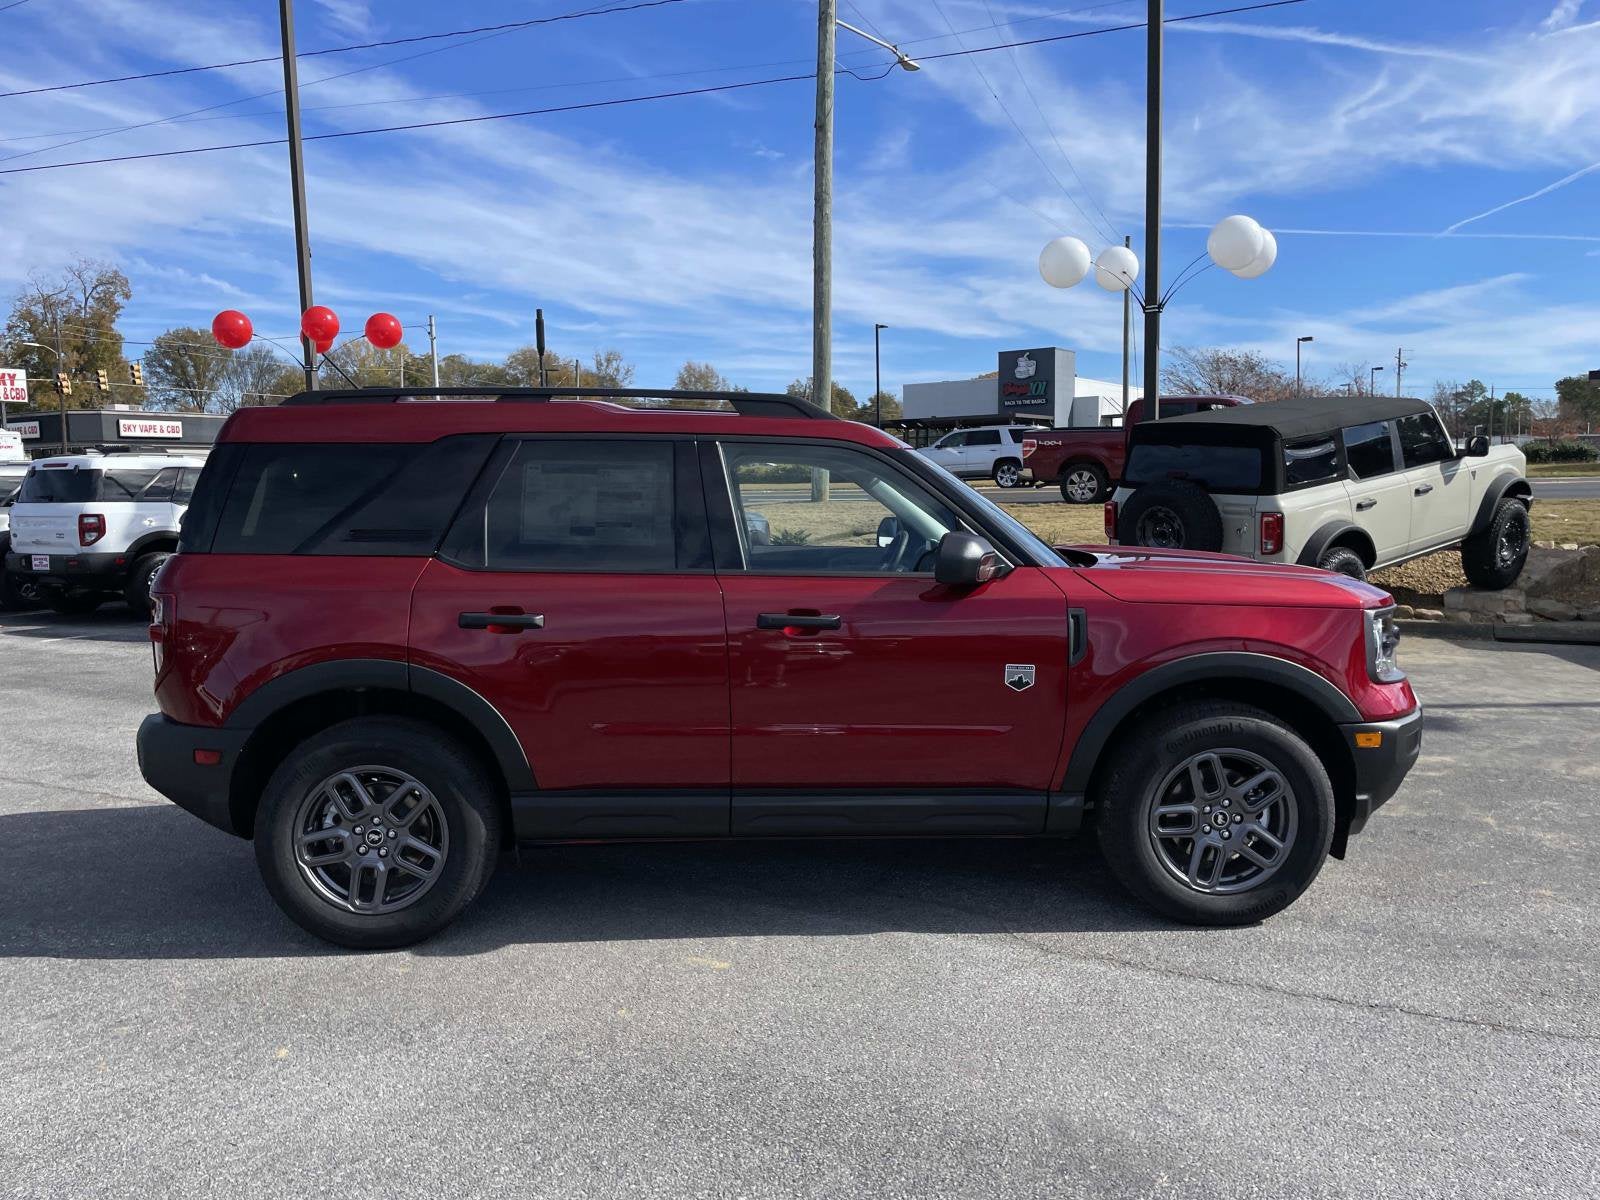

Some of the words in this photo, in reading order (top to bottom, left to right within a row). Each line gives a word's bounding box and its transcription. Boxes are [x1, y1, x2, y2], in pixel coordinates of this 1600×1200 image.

[3, 387, 9, 400] &
[10, 387, 26, 400] CBD
[1030, 381, 1048, 396] 101
[28, 426, 38, 435] CBD
[122, 423, 137, 433] SKY
[138, 424, 158, 433] VAPE
[159, 424, 165, 434] &
[166, 425, 181, 434] CBD
